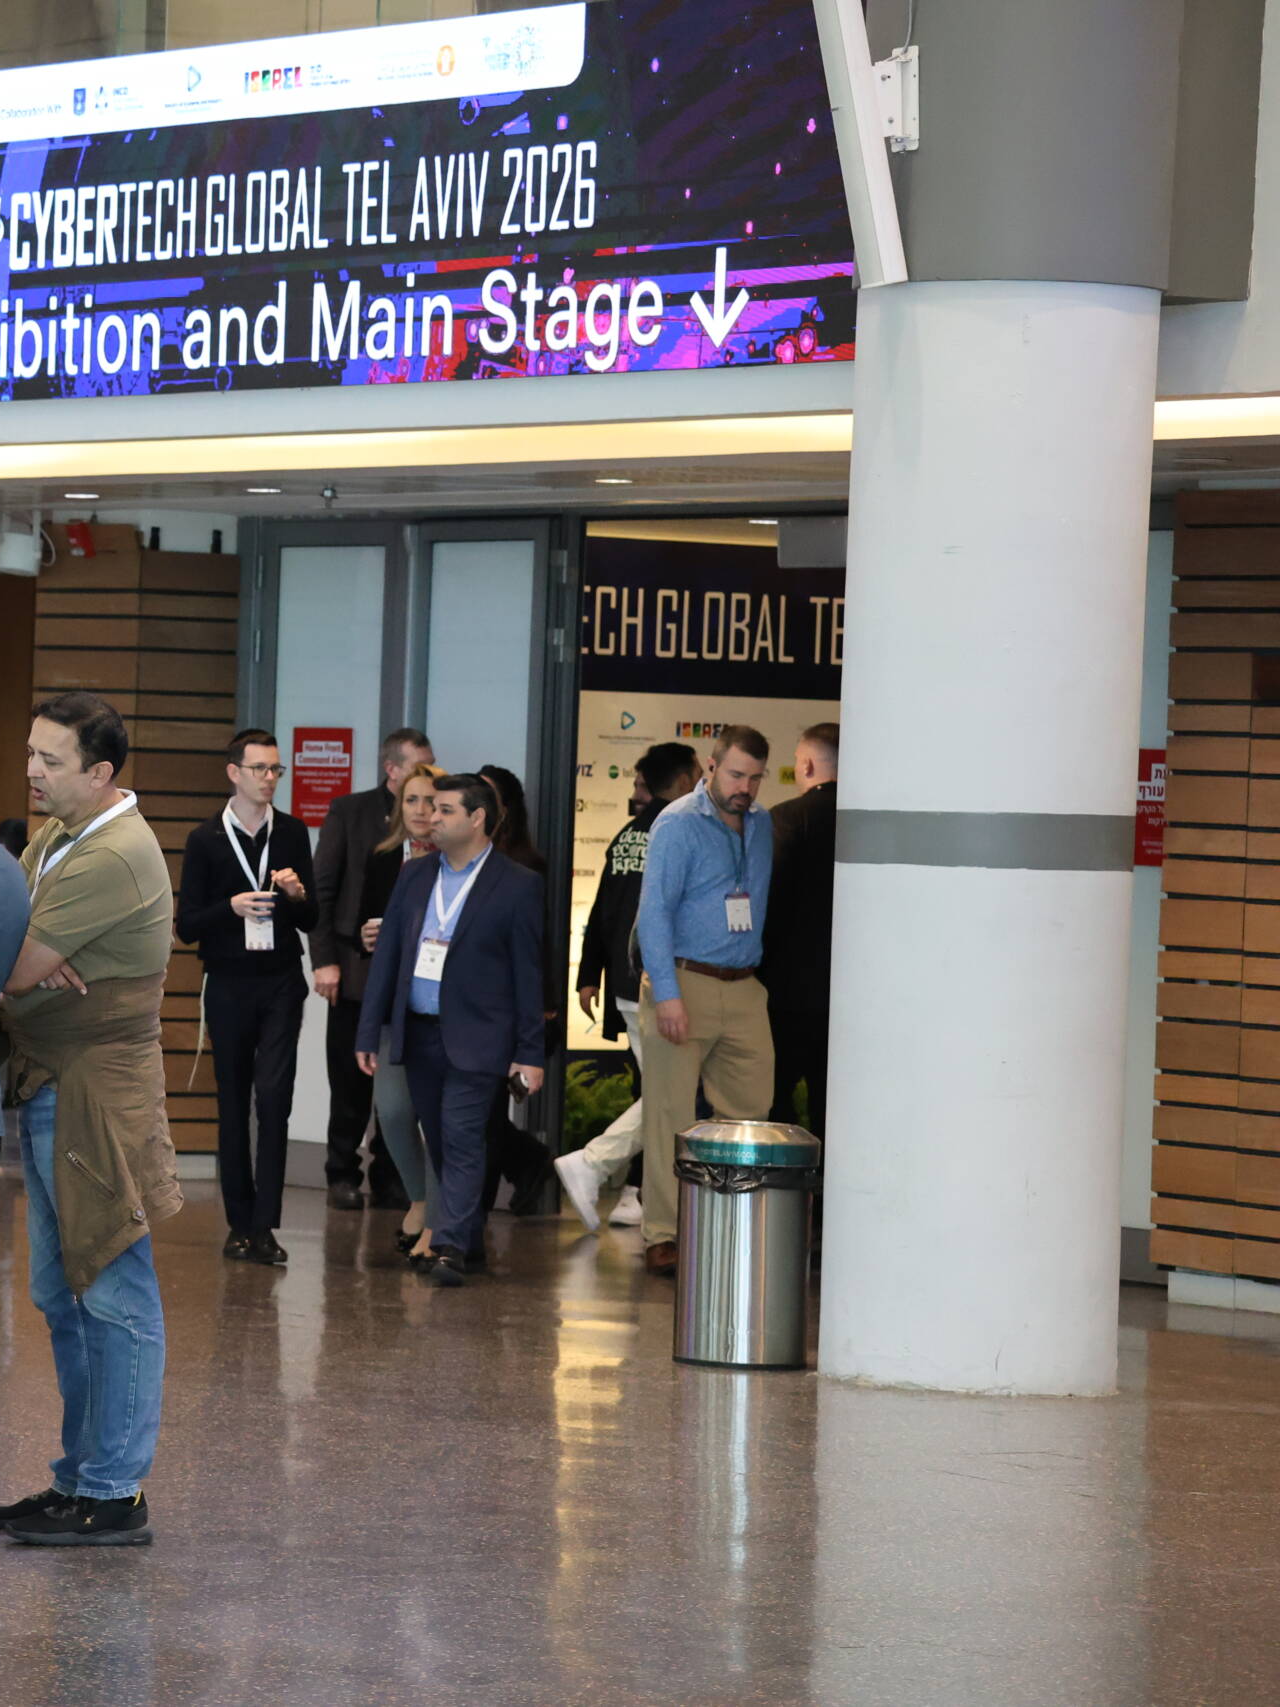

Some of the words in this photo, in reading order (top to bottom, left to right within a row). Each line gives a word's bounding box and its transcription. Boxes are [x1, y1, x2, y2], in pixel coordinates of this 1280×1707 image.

[9, 177, 197, 270] CYBERTECH
[205, 166, 328, 255] GLOBAL
[342, 160, 397, 246] TEL
[410, 151, 489, 241] AVIV
[500, 141, 596, 234] 2026
[182, 280, 286, 366] and
[311, 273, 452, 362] Main
[478, 269, 662, 371] Stage
[654, 588, 794, 664] GLOBAL
[676, 722, 729, 738] ISRAE
